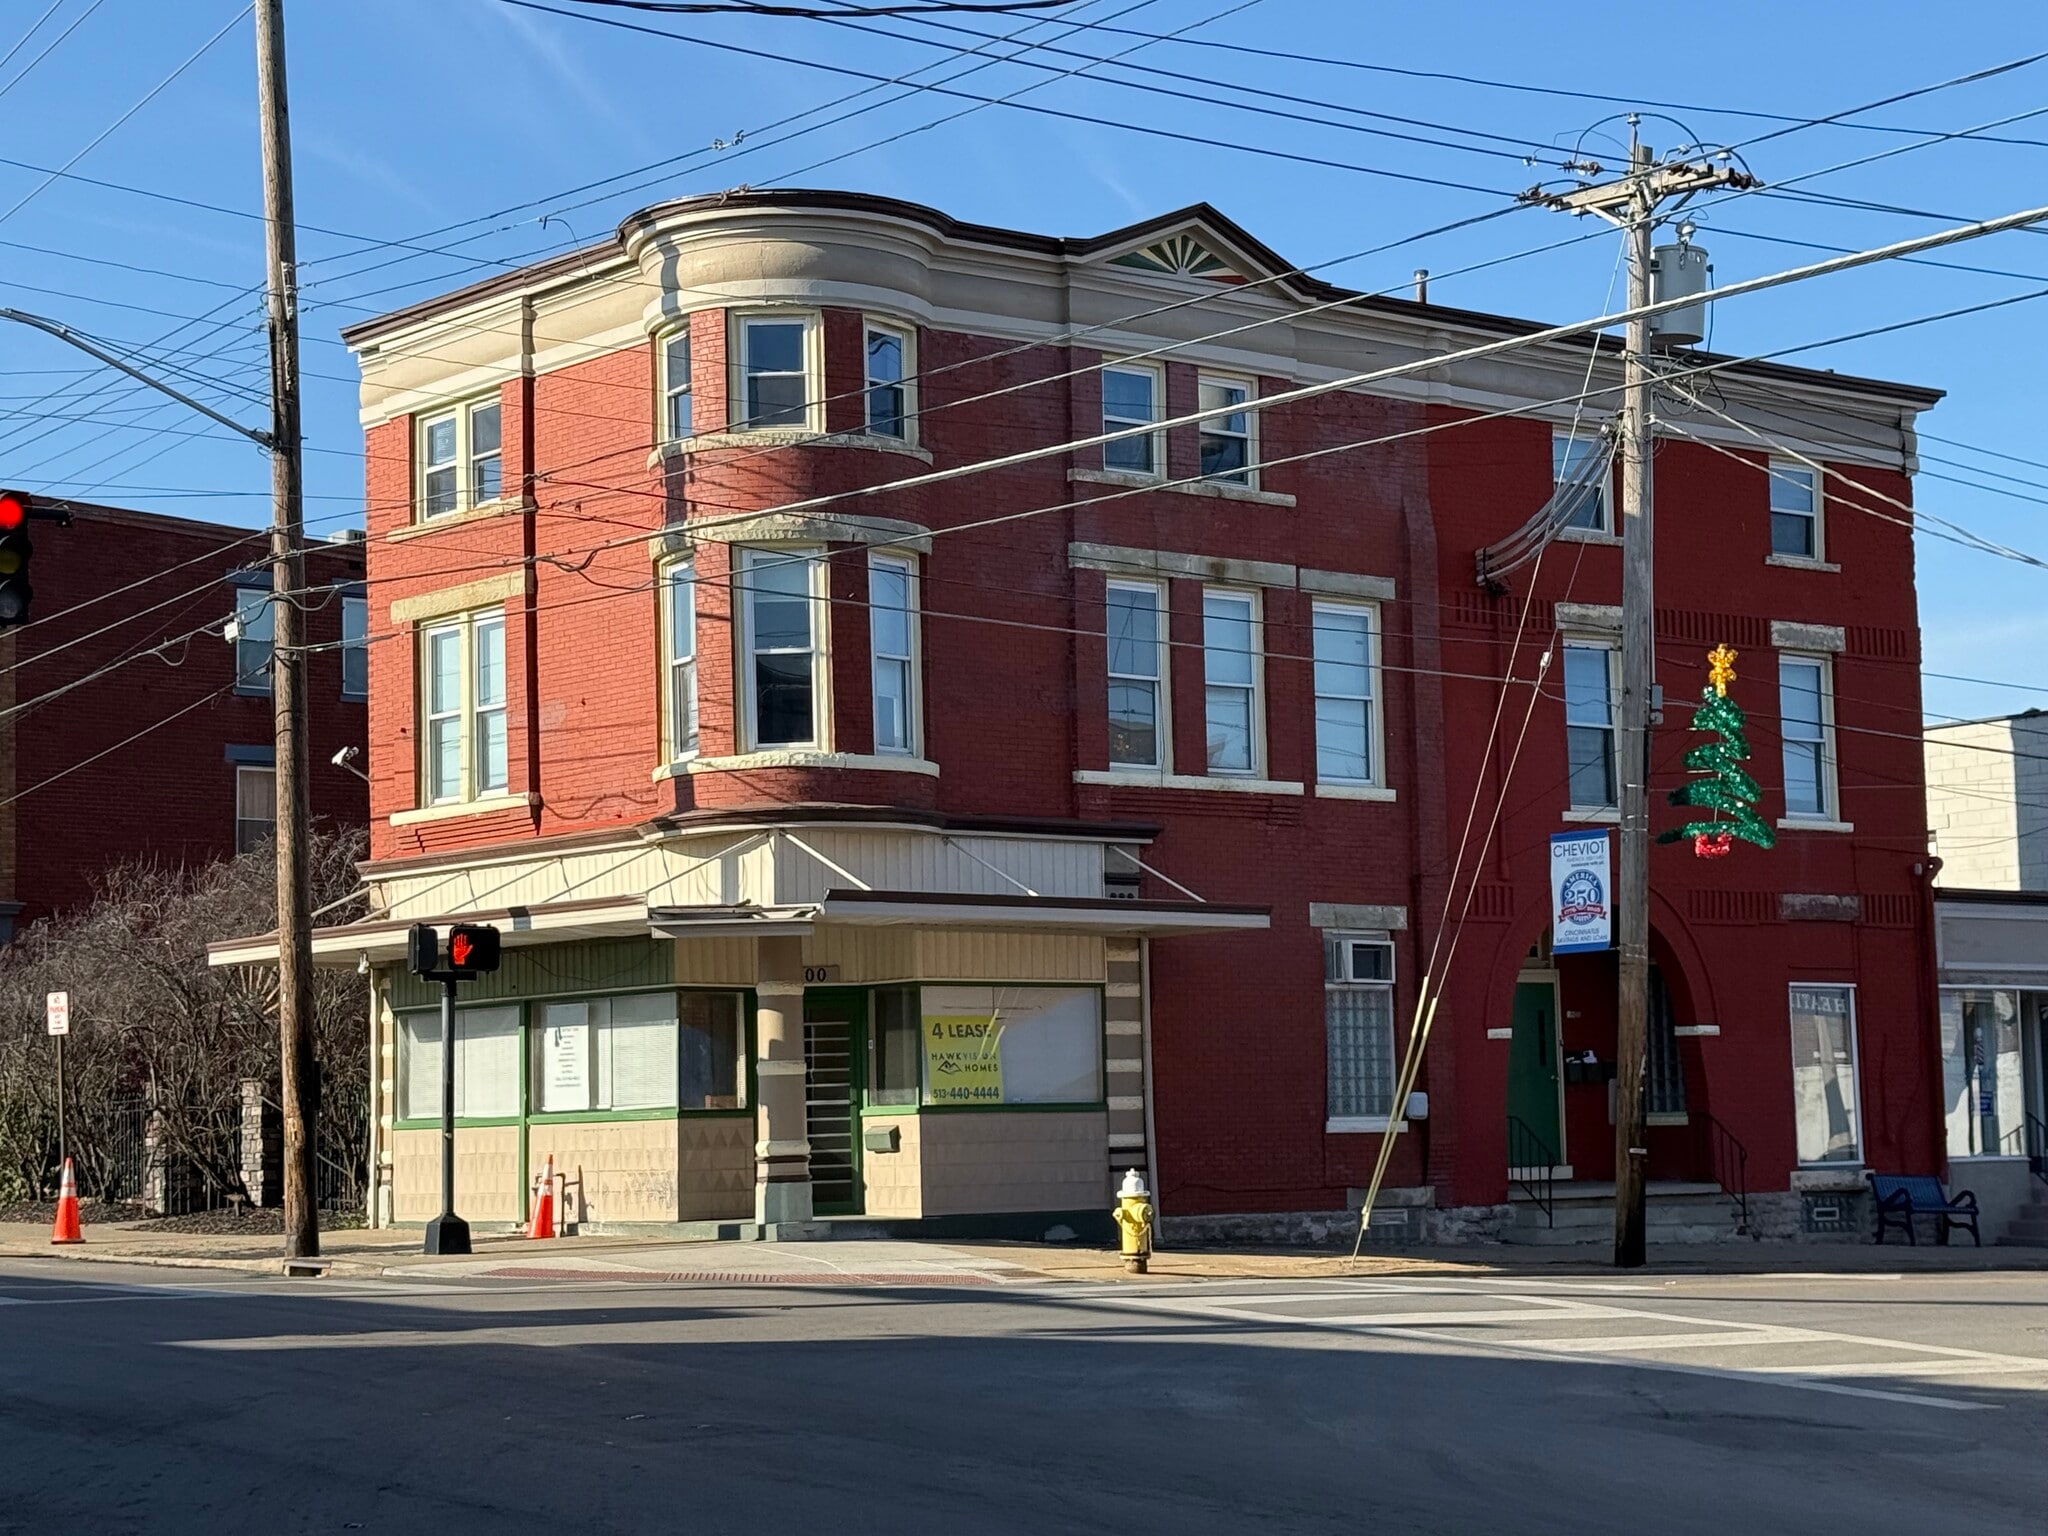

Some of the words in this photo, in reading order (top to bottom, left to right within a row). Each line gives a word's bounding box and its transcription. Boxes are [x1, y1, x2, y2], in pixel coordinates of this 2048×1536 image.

[1553, 841, 1605, 857] CHEVIOT
[1566, 872, 1598, 886] AMERICA
[1565, 888, 1599, 908] 250
[932, 1022, 944, 1039] 4
[931, 1052, 996, 1060] HAWKVISON
[964, 1063, 998, 1072] HOMES
